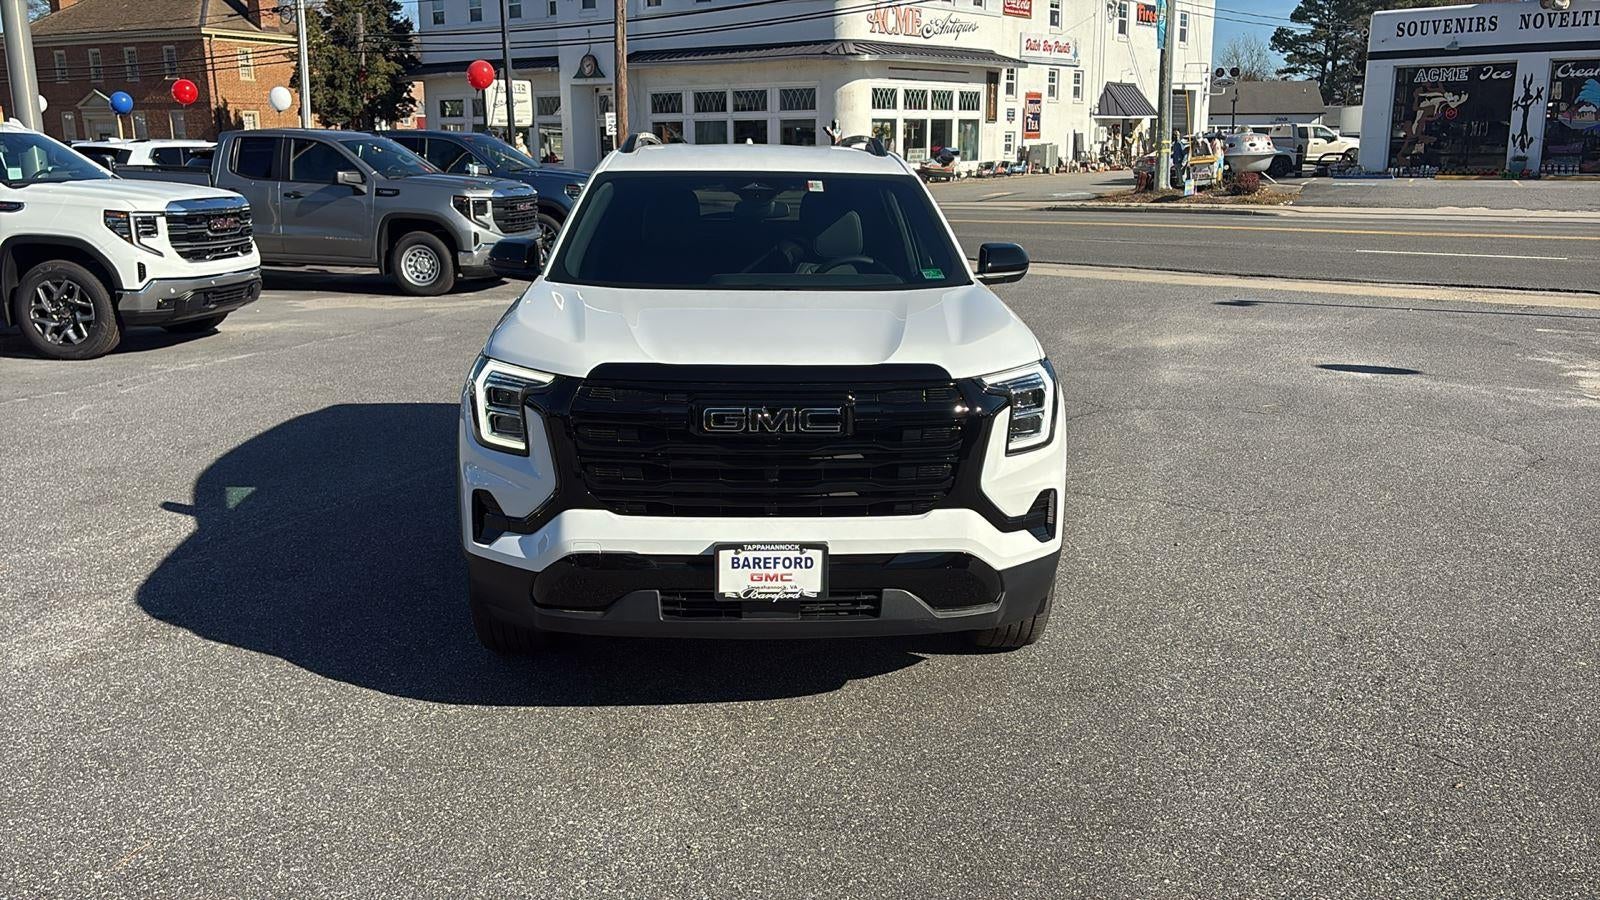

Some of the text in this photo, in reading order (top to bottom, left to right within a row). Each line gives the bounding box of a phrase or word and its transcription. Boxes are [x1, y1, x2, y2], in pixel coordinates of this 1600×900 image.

[866, 6, 922, 37] ACME
[1396, 15, 1499, 38] SOUVENIRS
[1413, 67, 1471, 83] ACME
[1479, 66, 1513, 81] Ice
[703, 407, 843, 433] GMC
[731, 556, 815, 570] BAREFORD
[750, 572, 794, 582] GMC
[740, 588, 804, 603] Bareford
